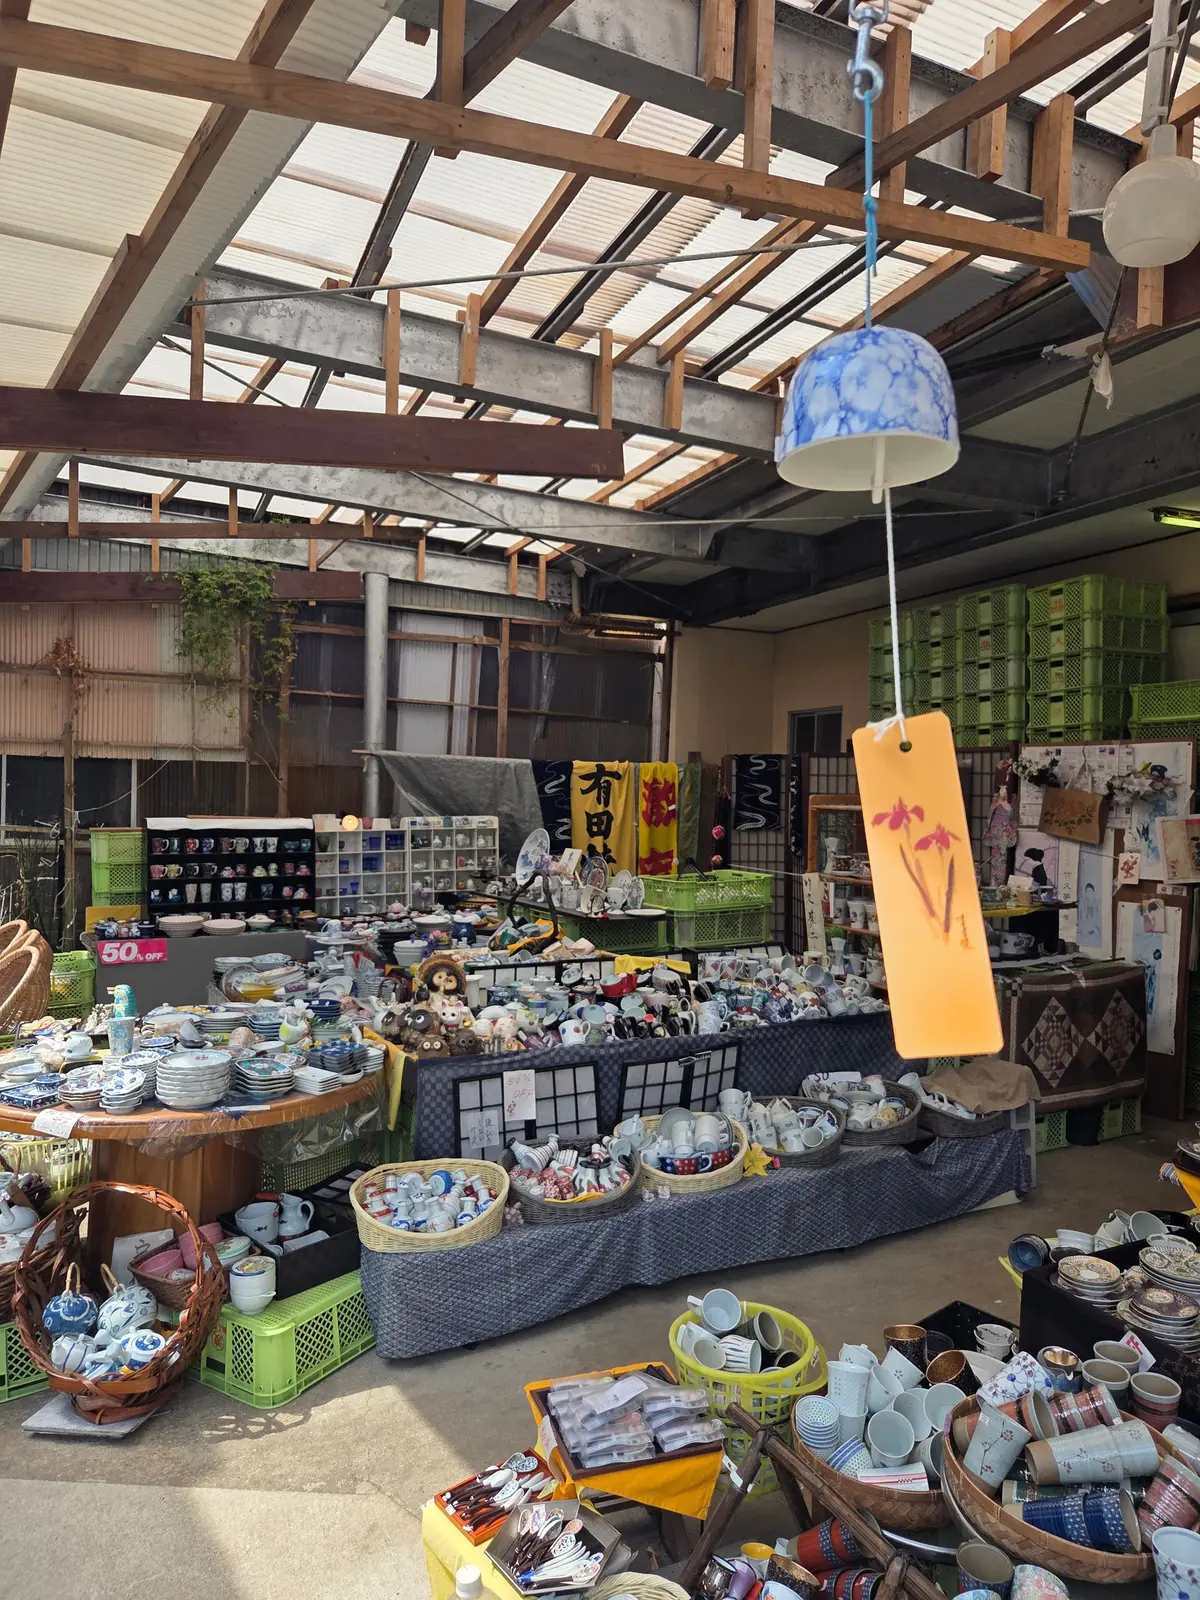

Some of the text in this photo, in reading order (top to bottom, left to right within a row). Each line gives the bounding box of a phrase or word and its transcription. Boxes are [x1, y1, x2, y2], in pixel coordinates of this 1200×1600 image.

[102, 941, 164, 962] 50% OFF
[514, 1088, 534, 1099] OFF
